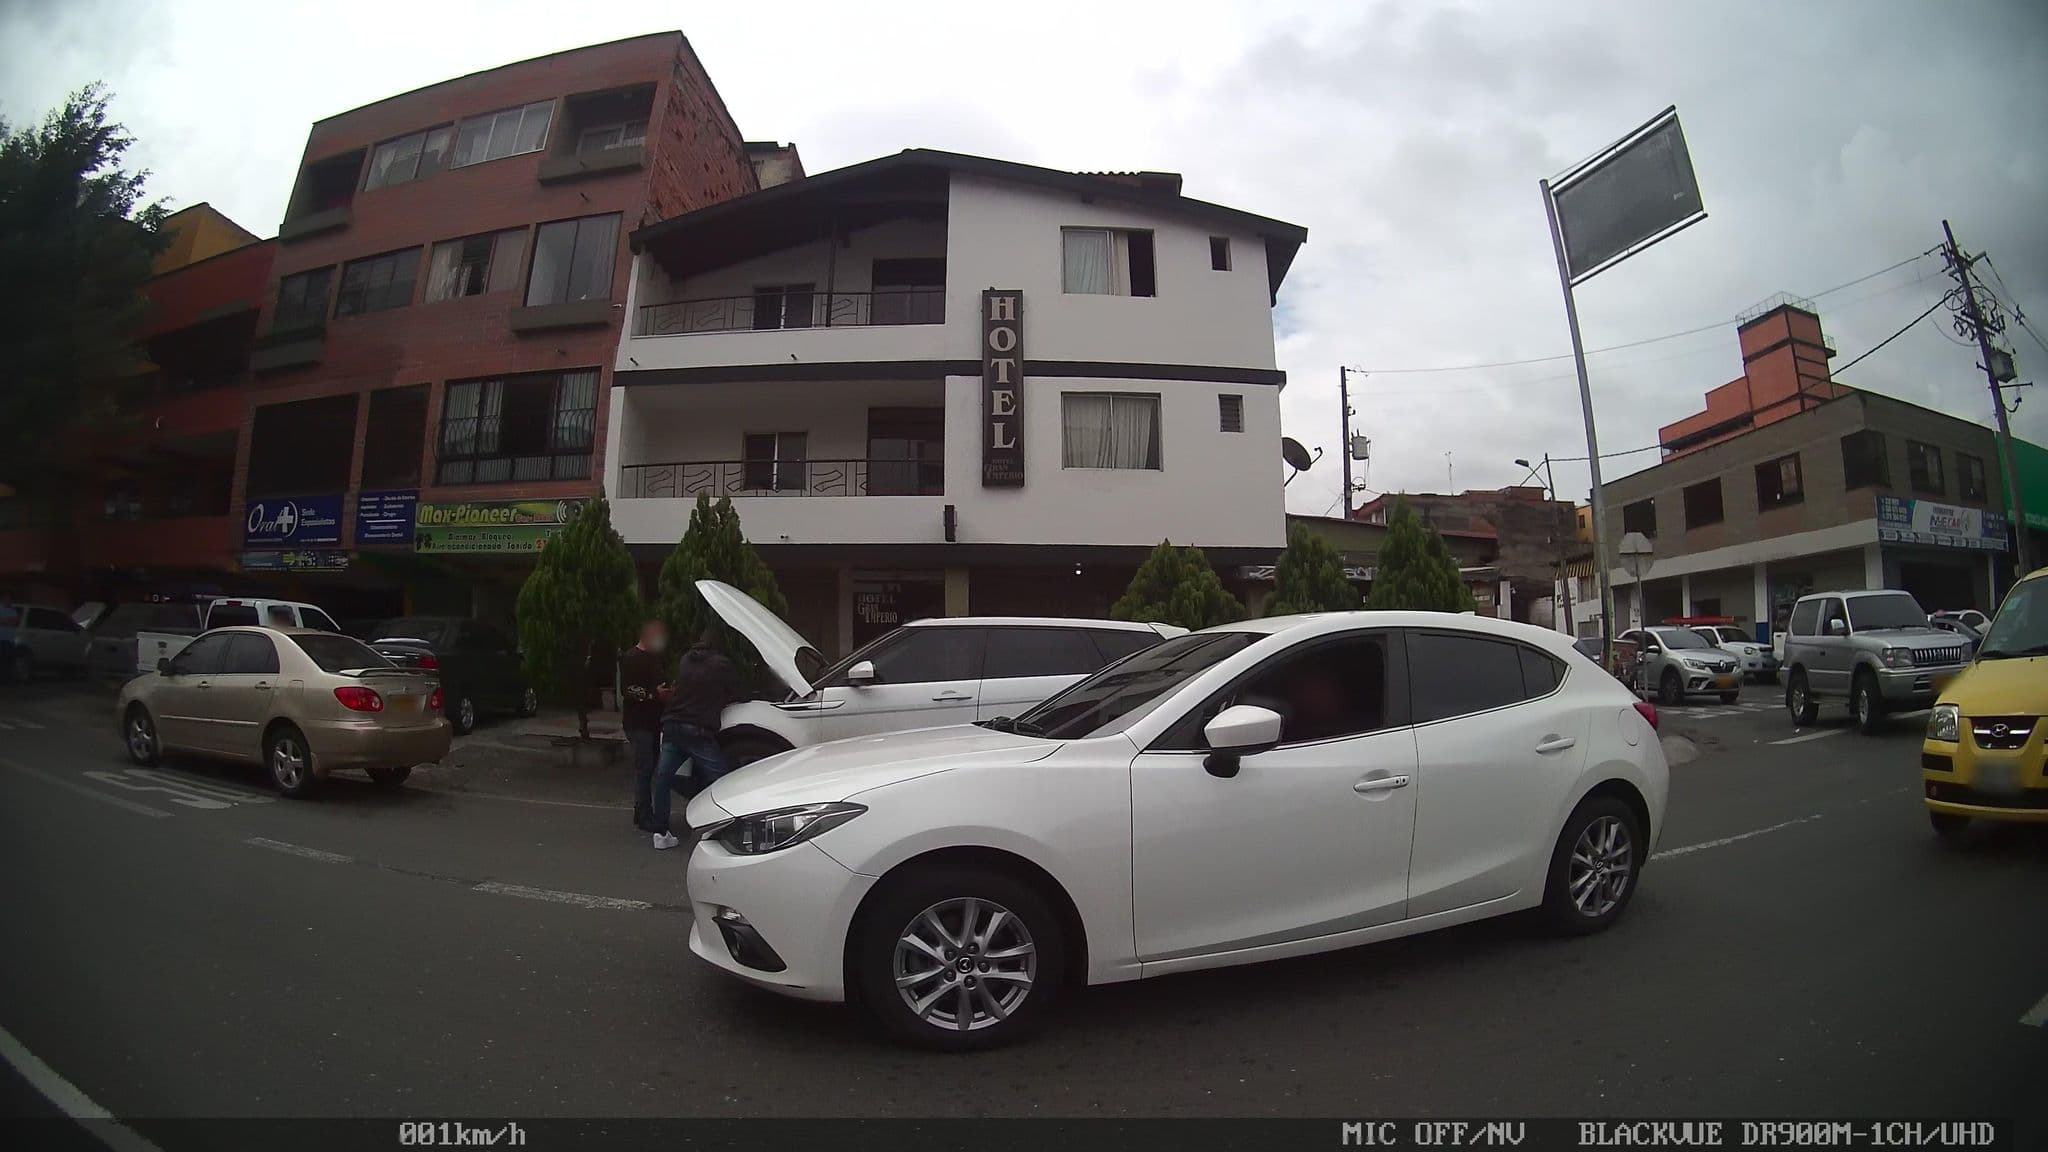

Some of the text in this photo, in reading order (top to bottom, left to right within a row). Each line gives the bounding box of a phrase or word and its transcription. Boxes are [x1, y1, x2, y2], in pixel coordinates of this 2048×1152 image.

[989, 297, 1016, 448] HOTEL
[419, 503, 517, 524] Max-Pioneer
[858, 592, 896, 604] HOTEL
